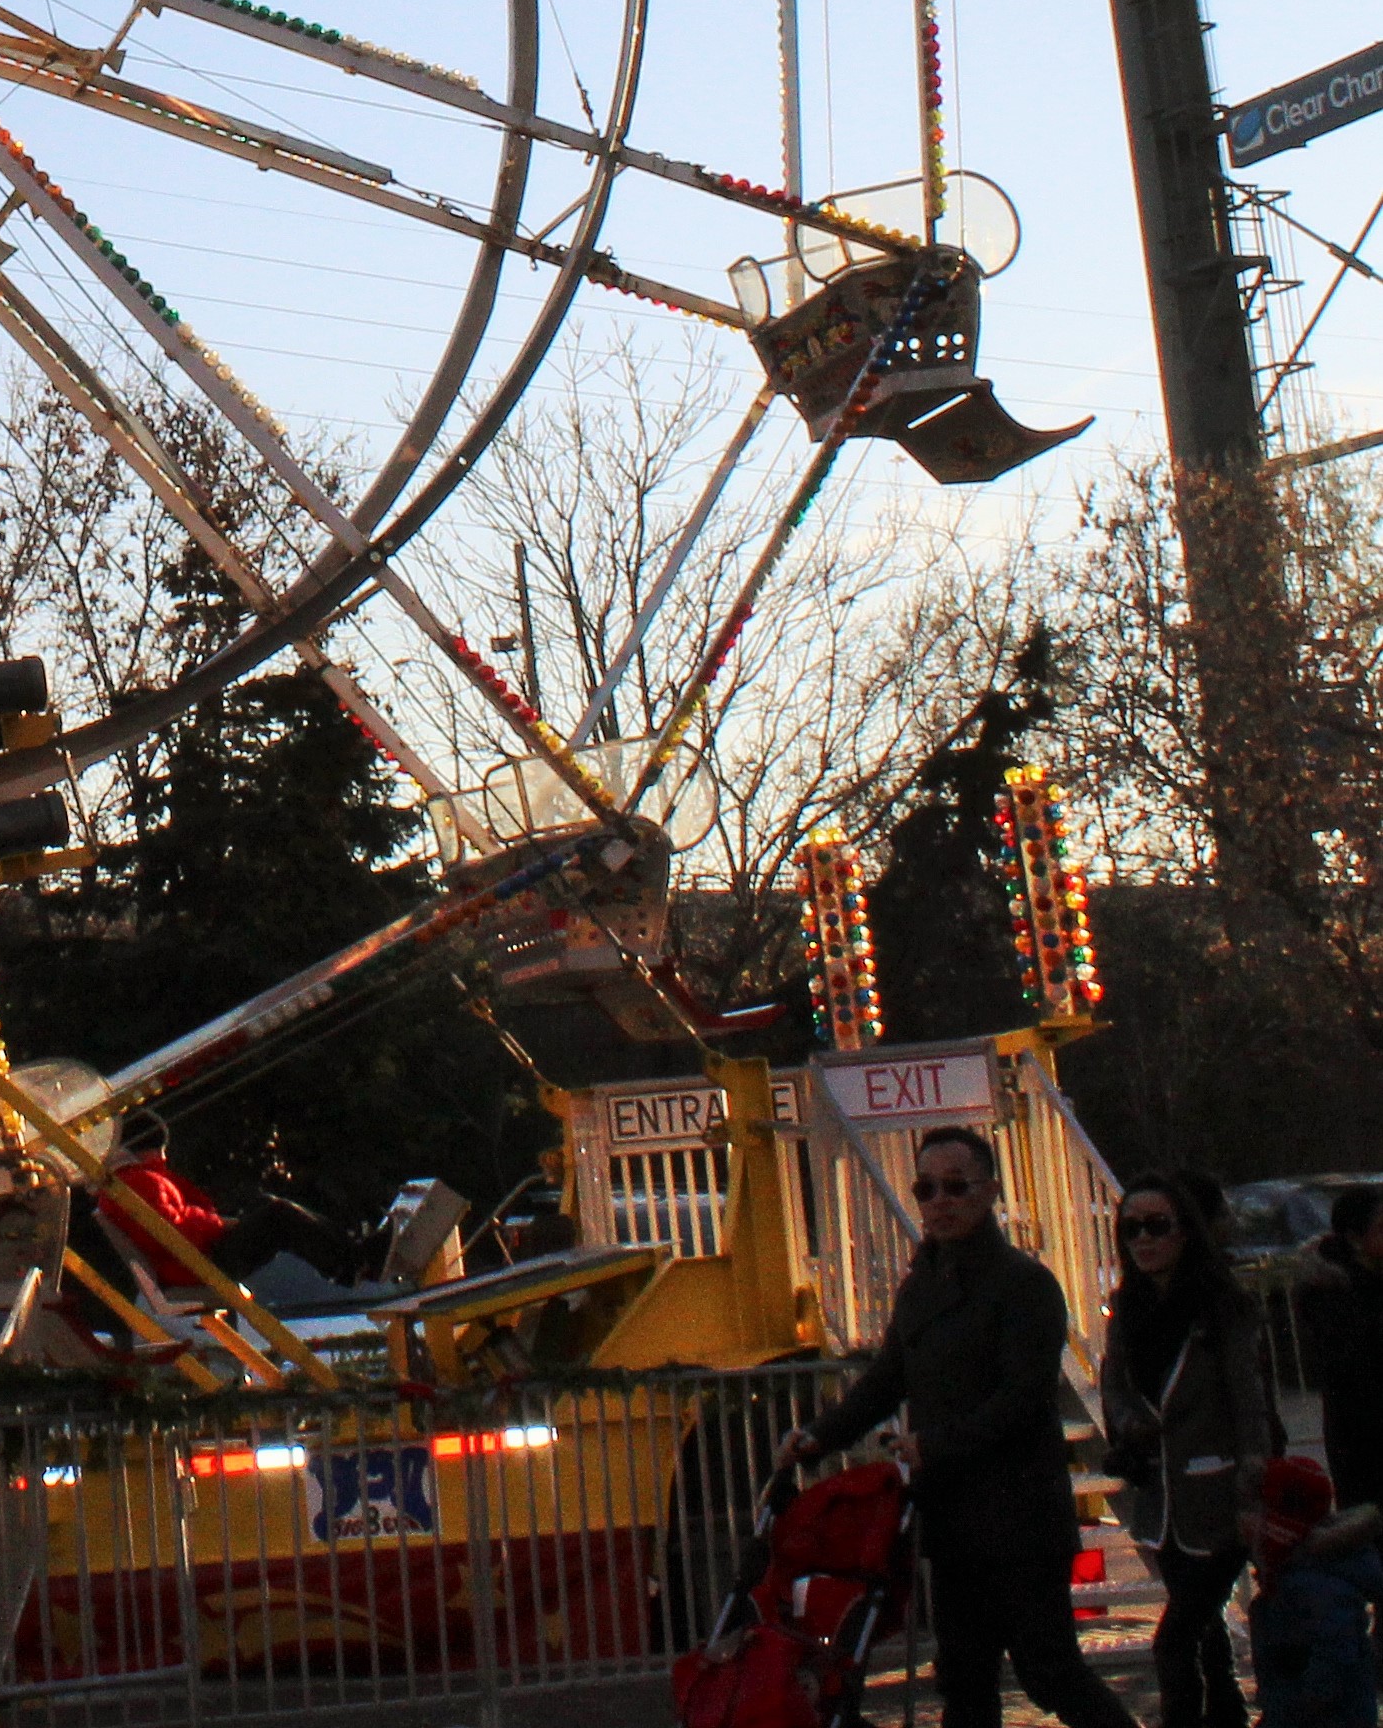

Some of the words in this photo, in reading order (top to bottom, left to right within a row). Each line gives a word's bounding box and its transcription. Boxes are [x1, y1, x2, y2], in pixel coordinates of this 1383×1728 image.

[1265, 91, 1326, 135] Clear
[614, 1084, 794, 1138] ENTRAE
[865, 1062, 946, 1112] EXIT
